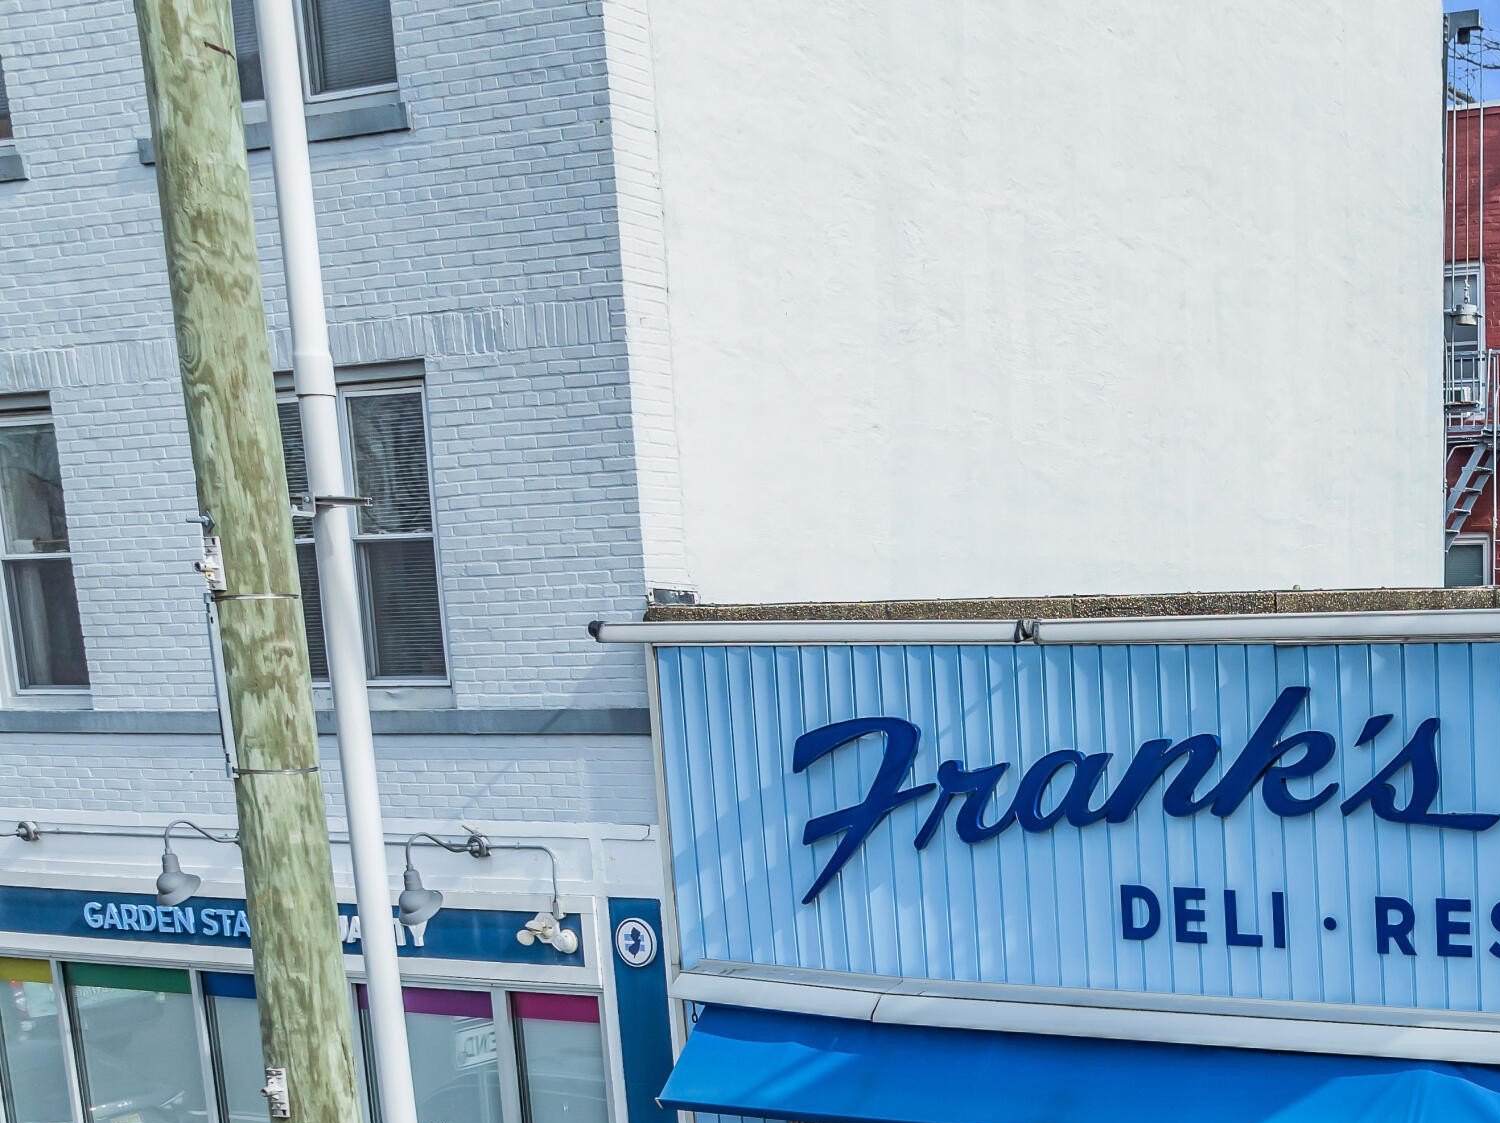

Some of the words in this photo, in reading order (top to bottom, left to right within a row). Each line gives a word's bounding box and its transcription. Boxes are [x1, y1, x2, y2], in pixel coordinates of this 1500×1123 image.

[84, 902, 196, 934] GARDEN
[200, 908, 251, 938] STA
[1120, 884, 1286, 949] DELI
